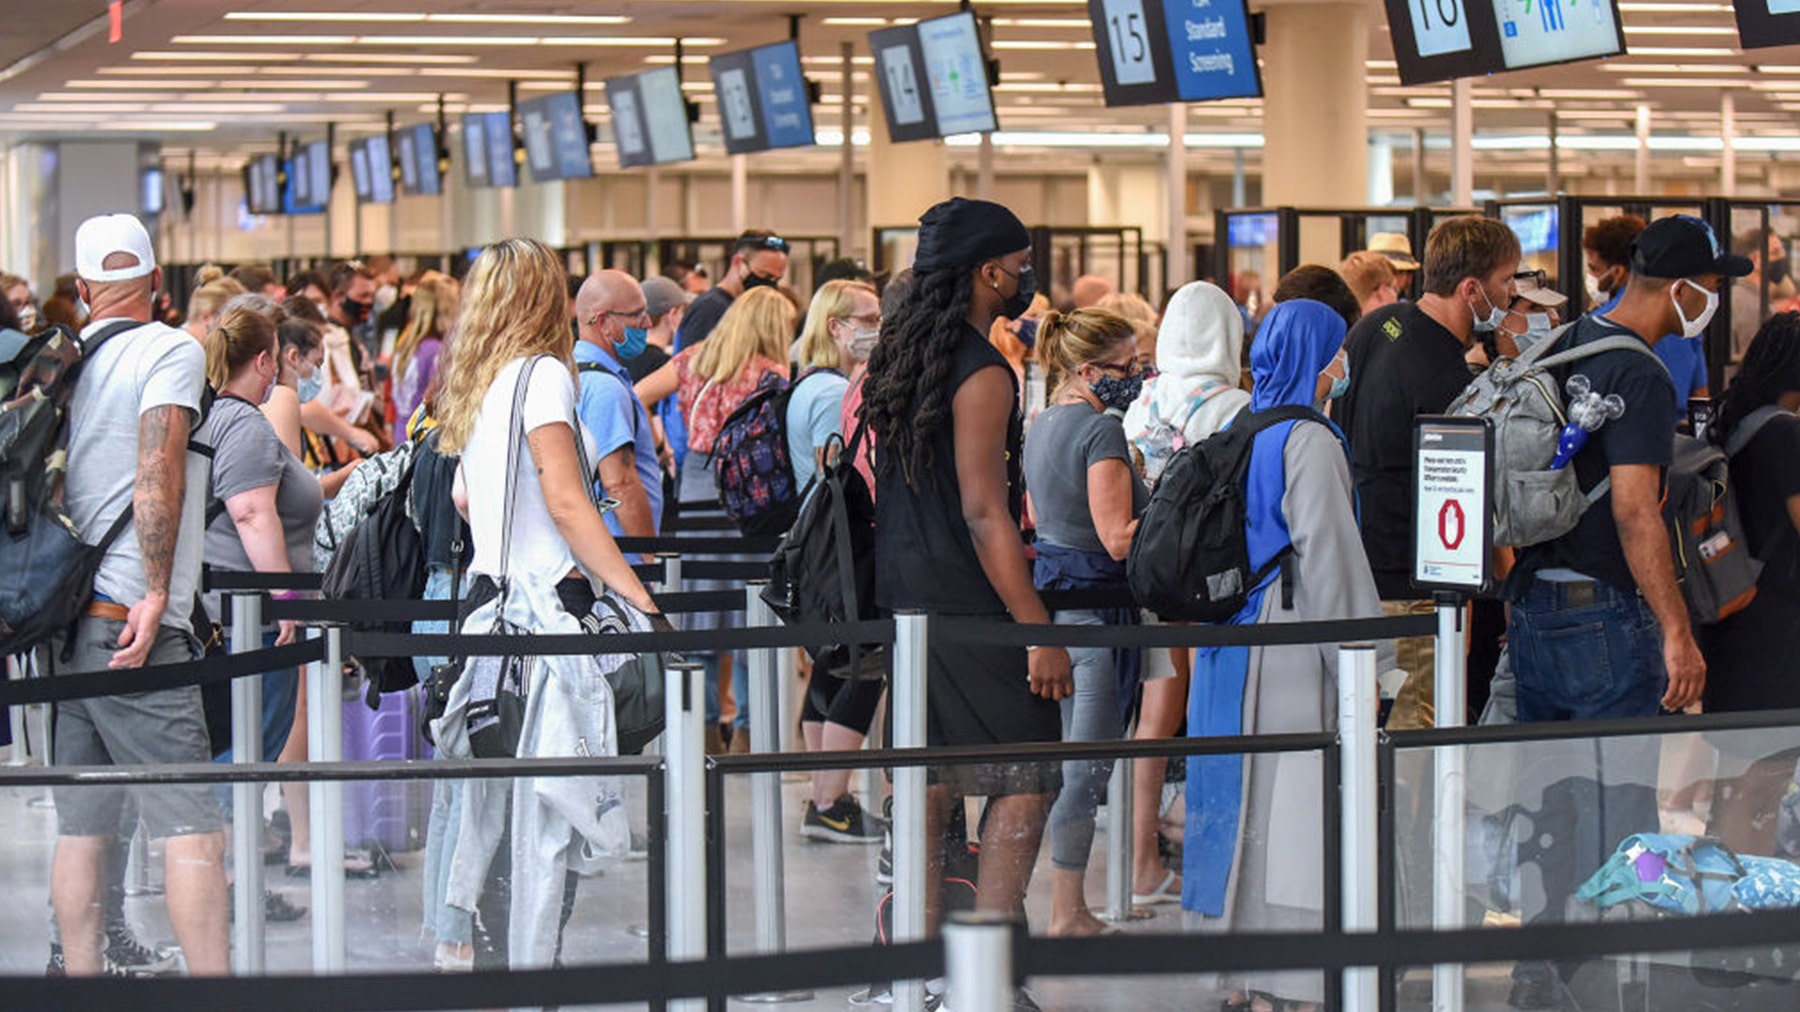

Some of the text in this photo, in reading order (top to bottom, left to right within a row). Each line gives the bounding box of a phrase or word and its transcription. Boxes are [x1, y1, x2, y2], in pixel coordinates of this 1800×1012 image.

[1112, 13, 1145, 64] 15
[1184, 15, 1227, 41] Standard
[1189, 48, 1235, 76] Screening
